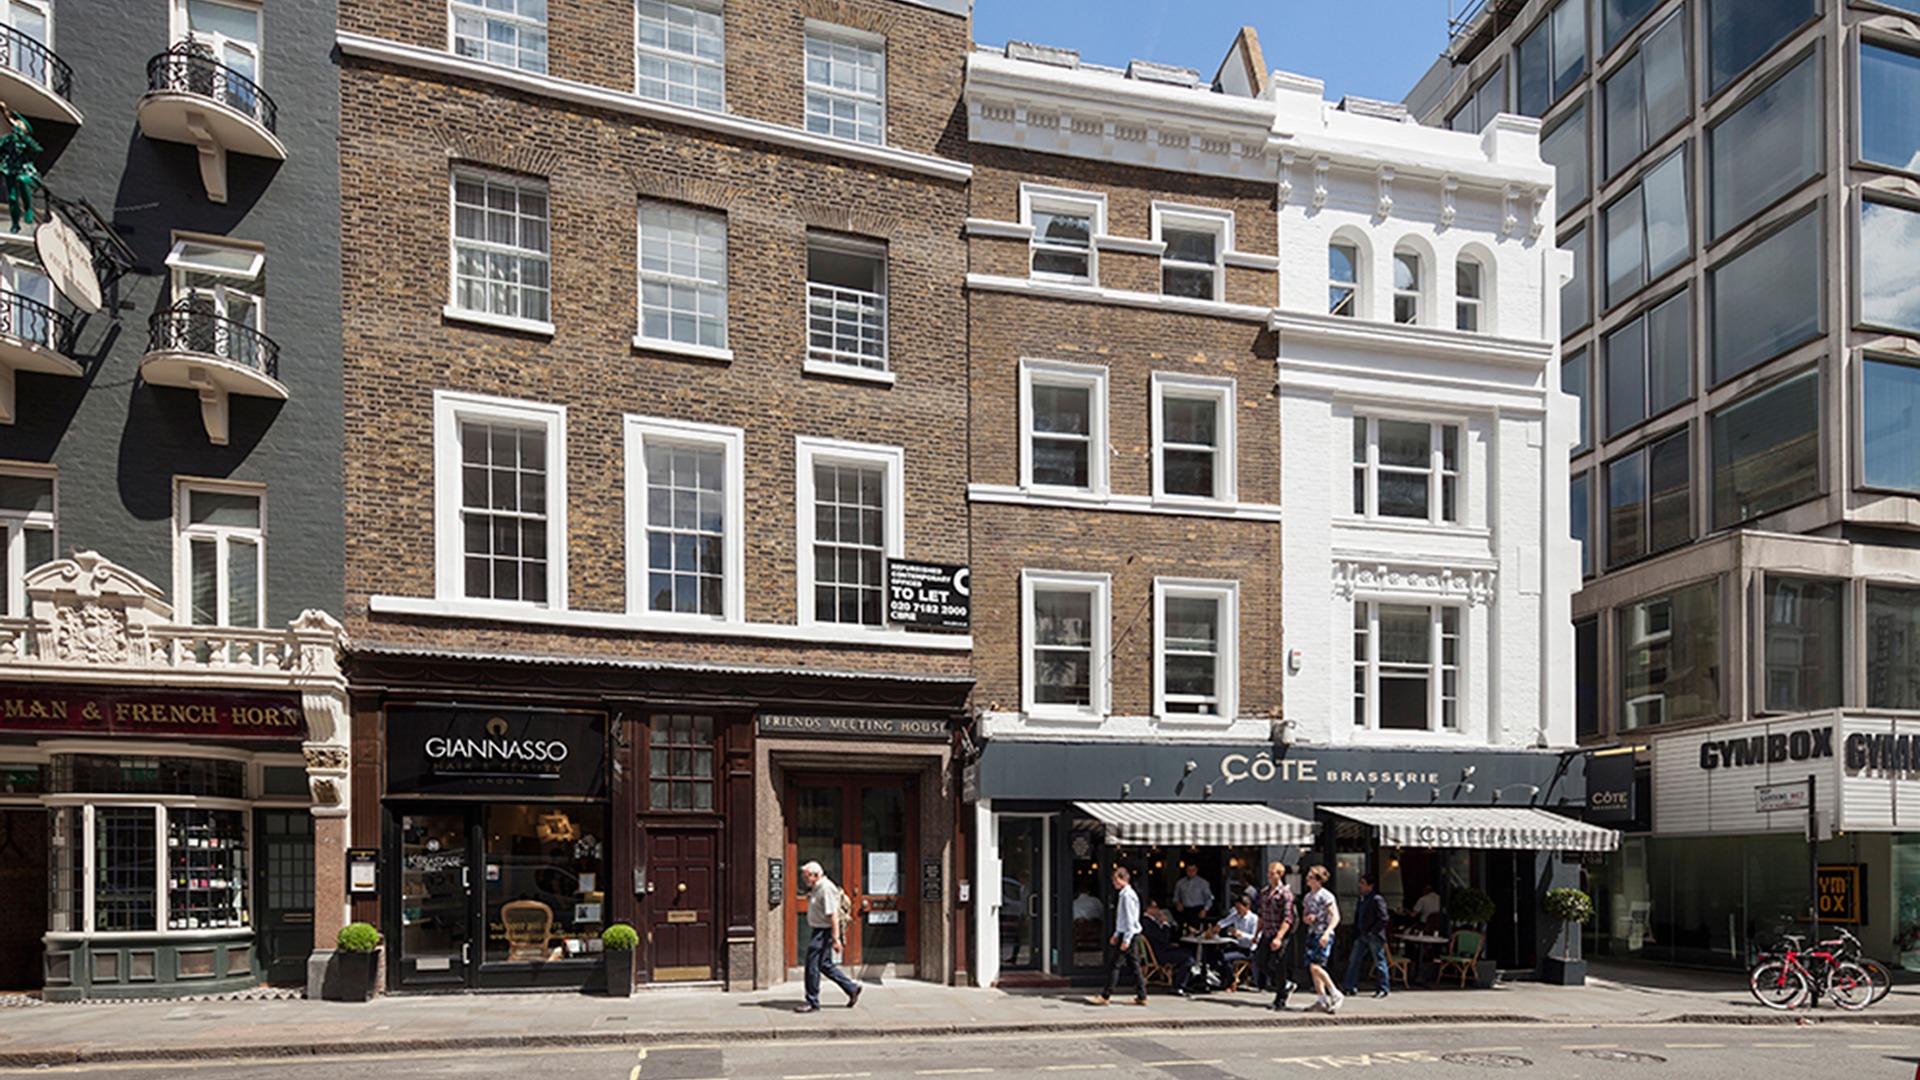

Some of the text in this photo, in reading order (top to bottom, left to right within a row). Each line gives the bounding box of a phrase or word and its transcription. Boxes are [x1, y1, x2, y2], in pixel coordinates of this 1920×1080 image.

[891, 586, 950, 603] TO LET
[890, 601, 967, 616] 020 7182 2000
[82, 701, 102, 720] &
[764, 715, 947, 733] FRIENDS MEETING HOUSE
[425, 737, 568, 761] GIANNASSO
[1700, 727, 1833, 769] GYMBOX
[1220, 752, 1439, 784] CÔTE BRASSERIE
[1592, 791, 1628, 804] CÔTE
[1820, 895, 1845, 912] OX
